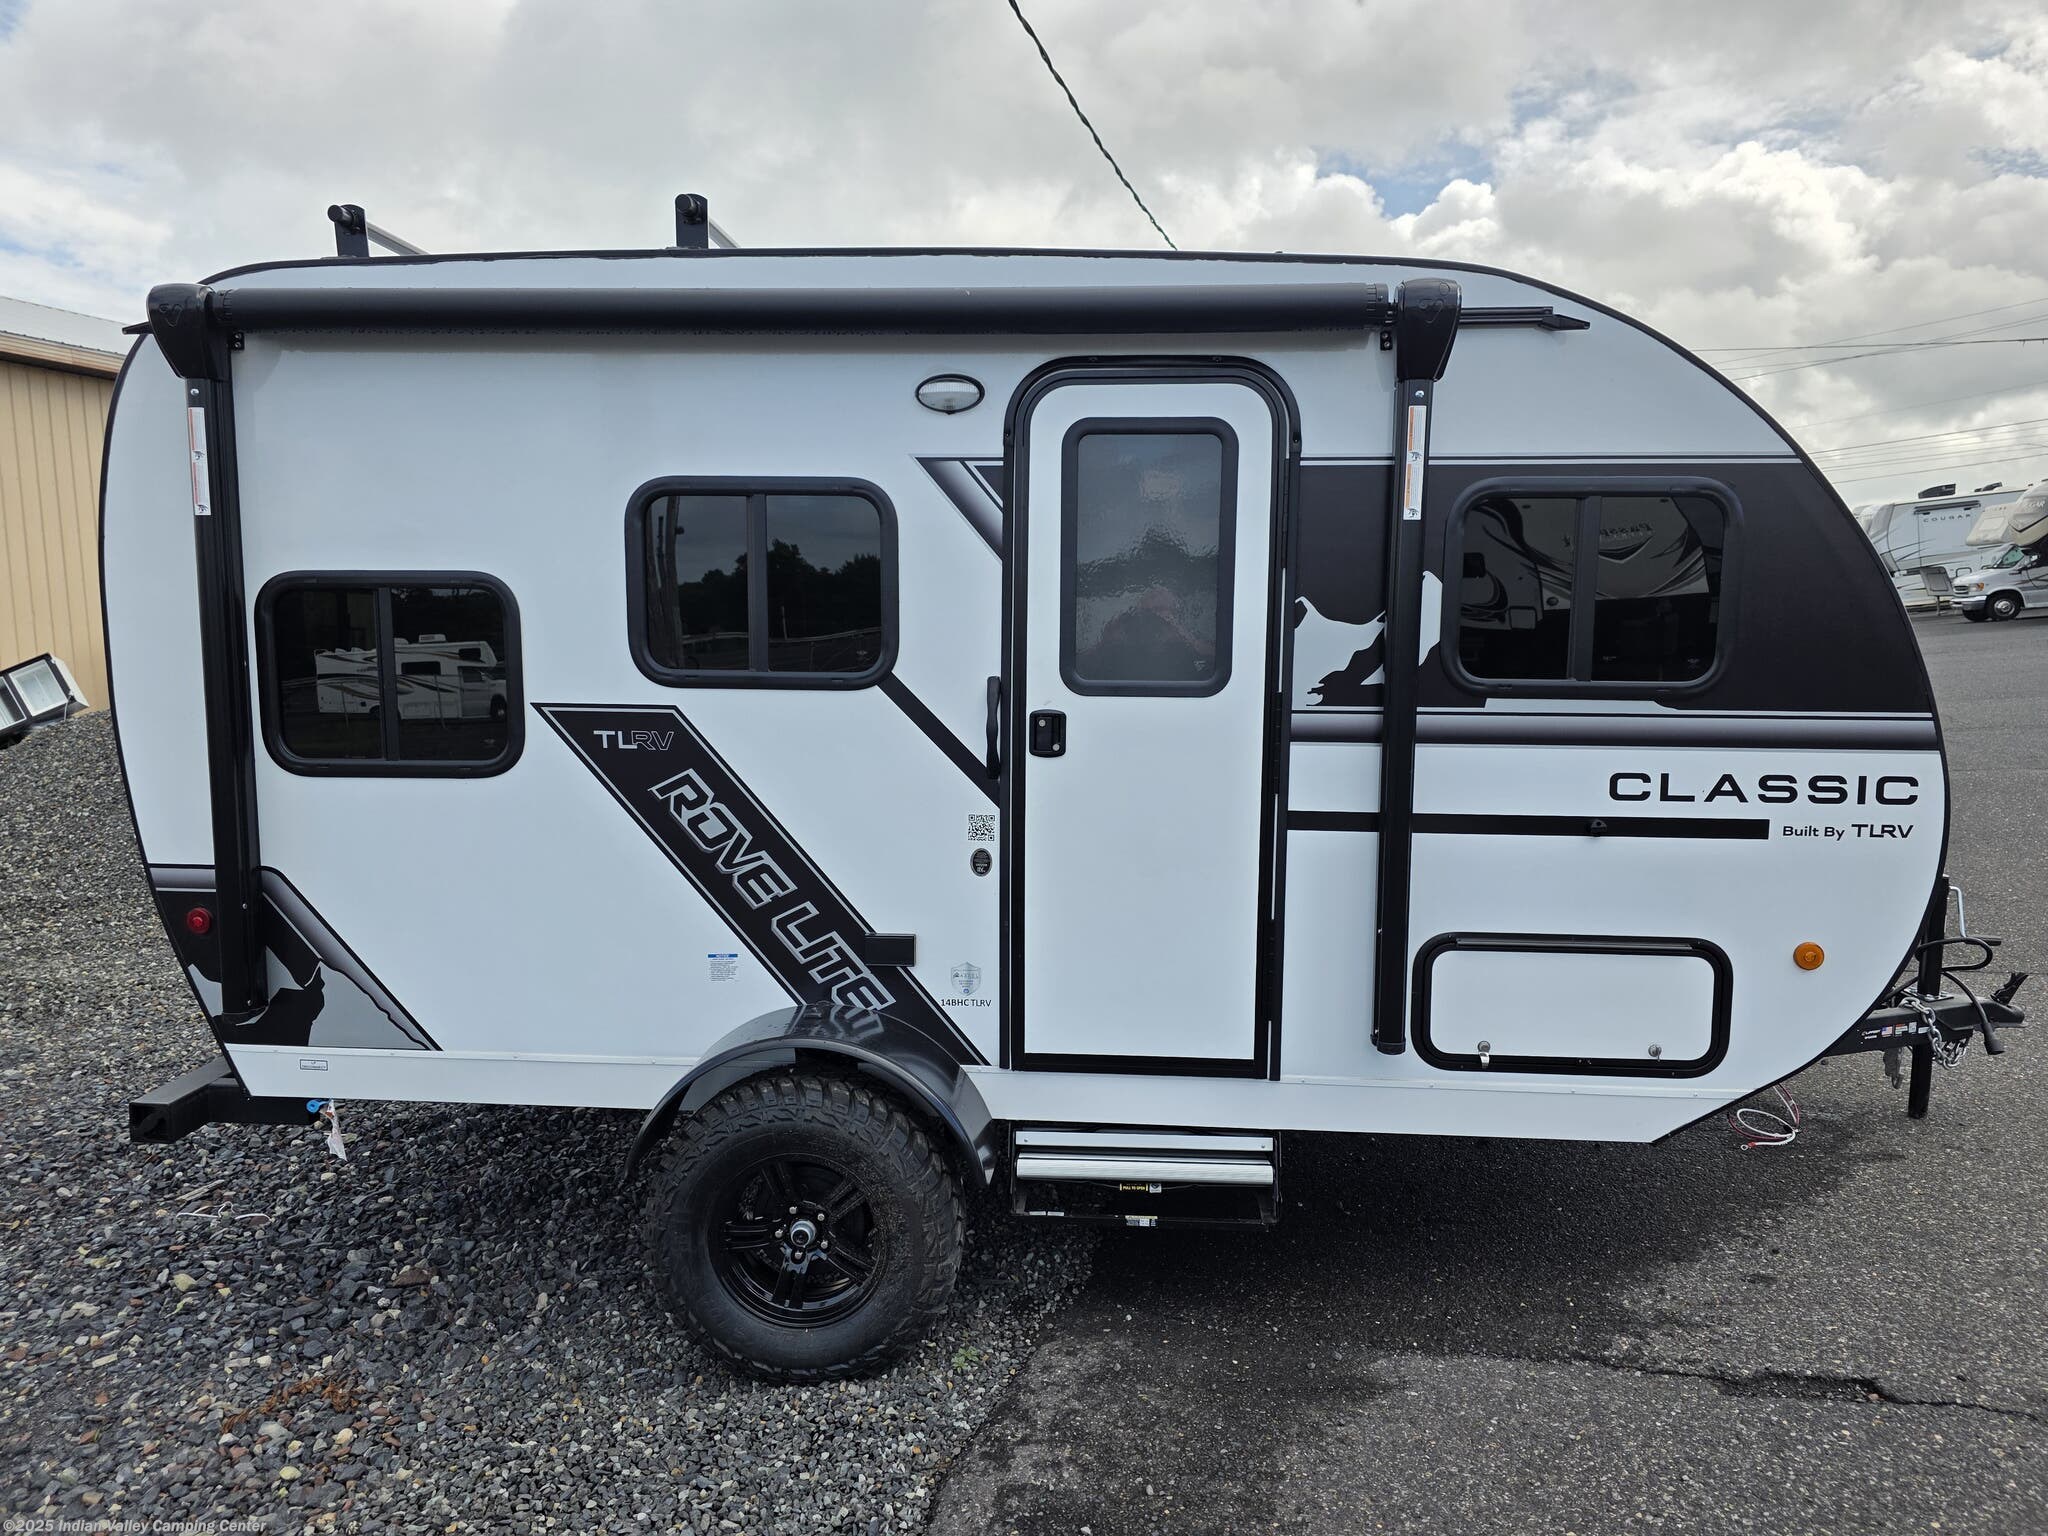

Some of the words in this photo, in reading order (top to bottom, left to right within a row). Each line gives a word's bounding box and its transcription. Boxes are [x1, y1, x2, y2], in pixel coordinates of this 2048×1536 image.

[1923, 514, 1971, 523] COUGAR
[593, 730, 675, 751] TLRV
[1609, 773, 1919, 806] CLASSIC
[1782, 825, 1819, 837] Built
[1824, 826, 1845, 841] By
[1851, 824, 1914, 839] TLRV
[648, 768, 798, 910] ROVE
[771, 901, 897, 1011] LITE
[941, 998, 969, 1007] 14BHC
[972, 999, 992, 1007] TLRV
